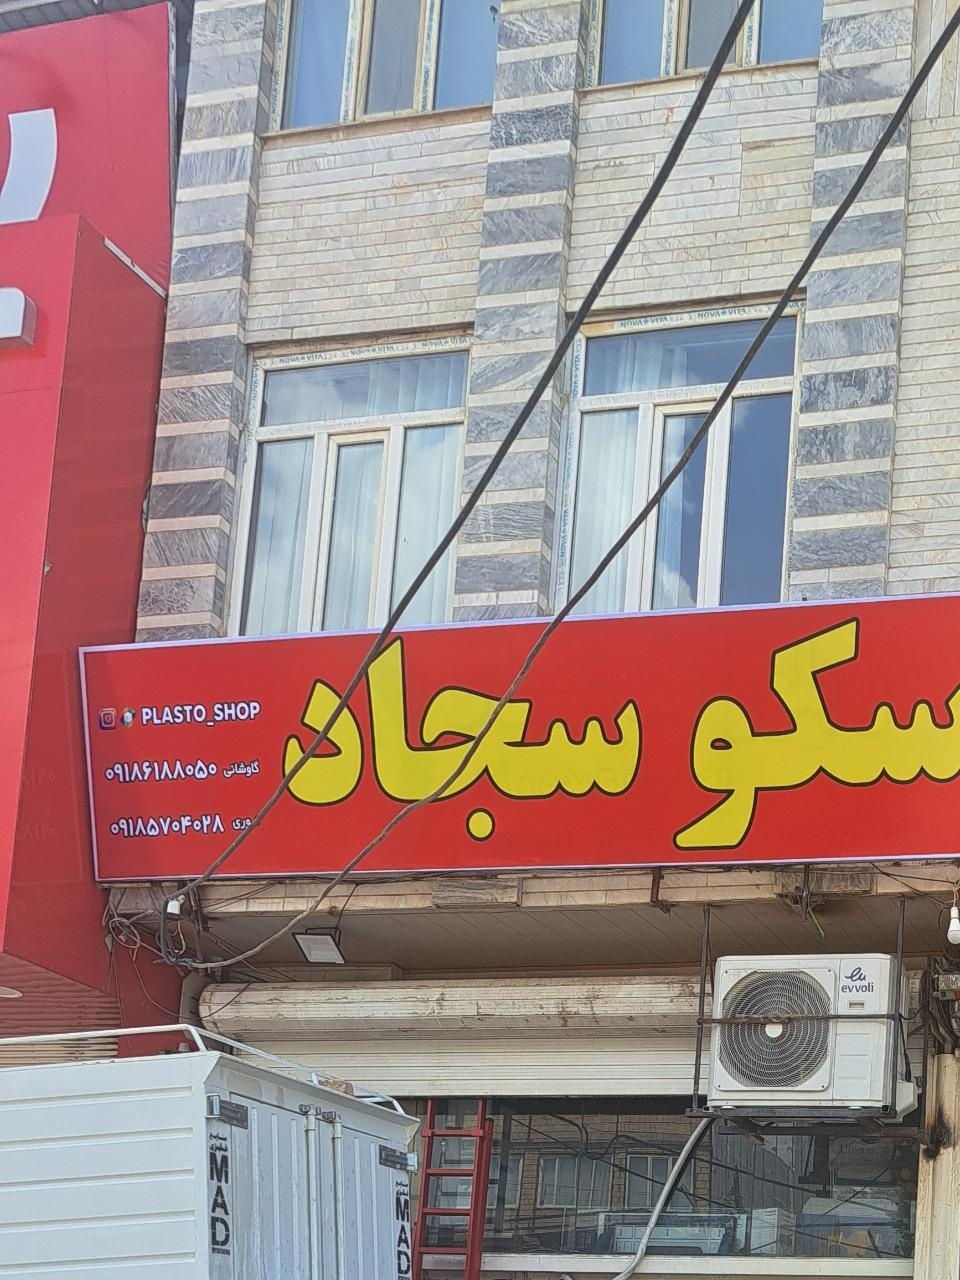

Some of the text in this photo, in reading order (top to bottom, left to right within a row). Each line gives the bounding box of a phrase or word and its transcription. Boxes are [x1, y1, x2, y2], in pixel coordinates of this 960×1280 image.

[697, 307, 747, 320] NOVA VITA
[620, 316, 668, 329] NOVA VITA
[377, 345, 395, 354] VITA
[422, 337, 468, 349] NOVA VITA
[279, 354, 324, 365] NOVA VITA
[142, 701, 261, 726] PLASTO_SHOP
[282, 637, 642, 841] سجاد
[105, 759, 217, 783] ۰۹۱۸۶۱۸۸۰۵۰
[110, 814, 256, 837] وری ۰۹۱۸۵۷۰۴۰۲۸
[841, 982, 875, 993] evvoli
